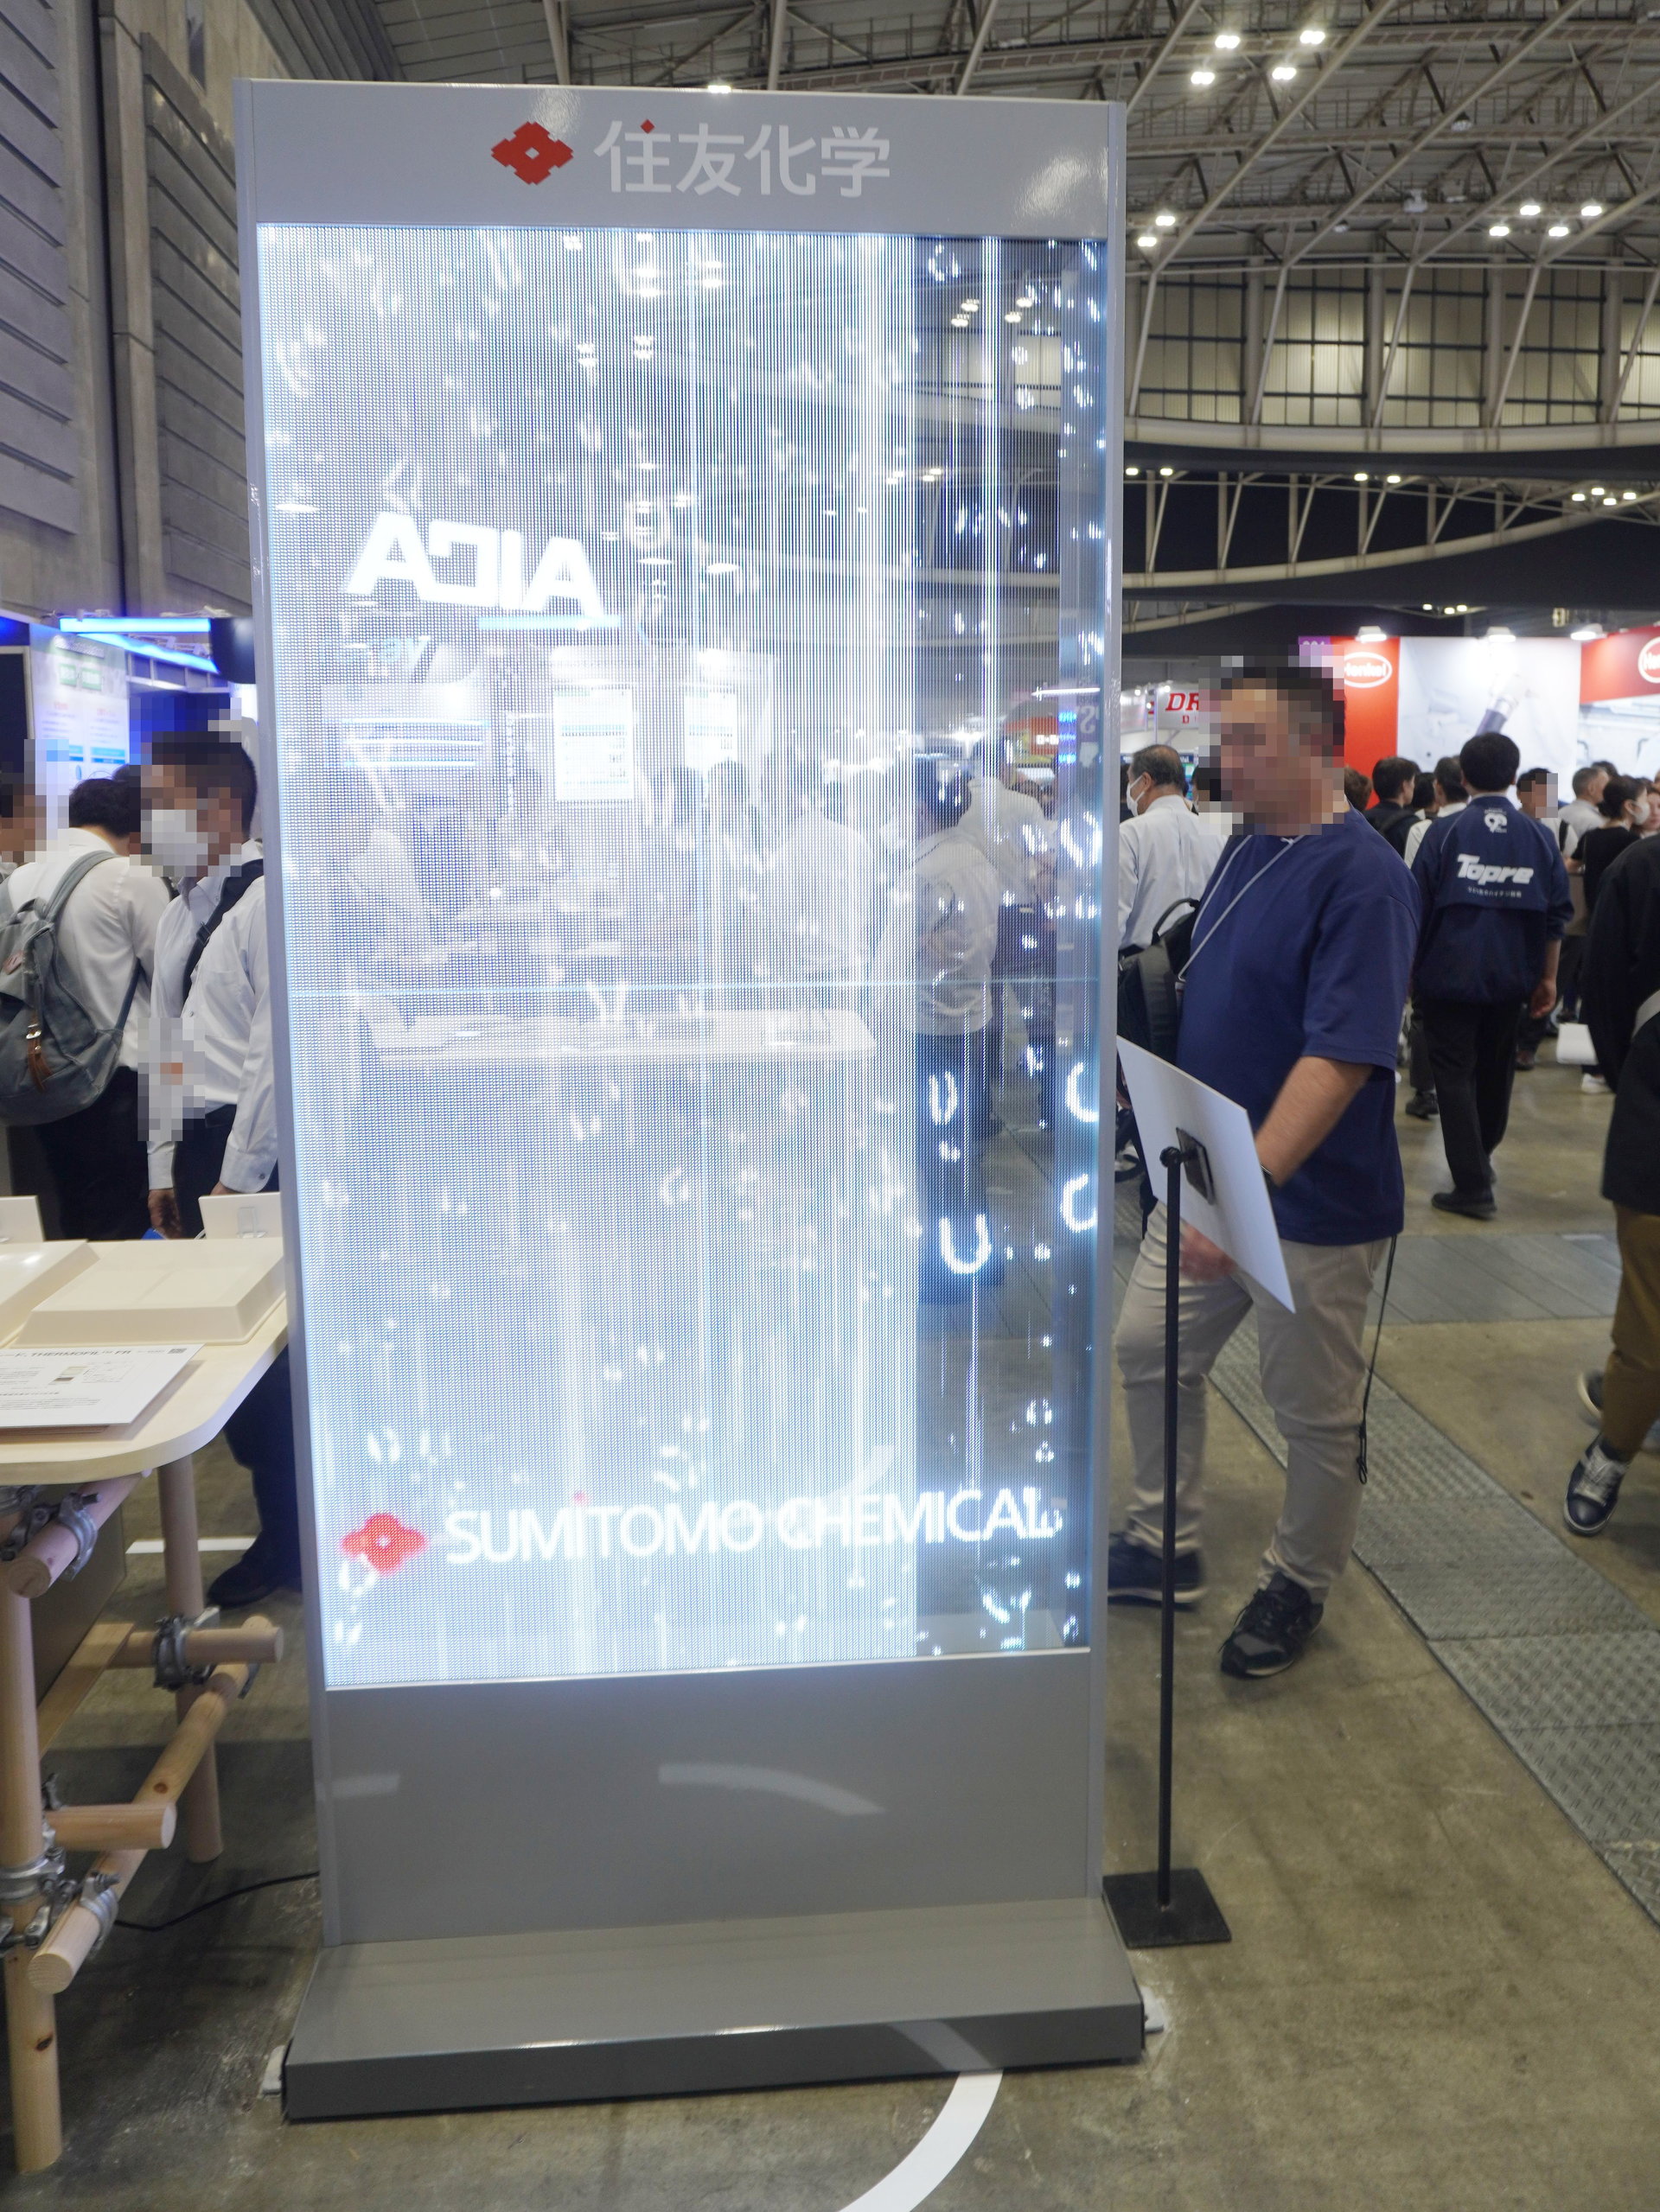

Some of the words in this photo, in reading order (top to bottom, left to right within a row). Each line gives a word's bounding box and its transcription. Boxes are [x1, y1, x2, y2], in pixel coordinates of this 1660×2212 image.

[594, 118, 891, 198] 住友化学
[1457, 853, 1534, 885] Topre
[444, 1493, 763, 1565] SUMITOMO
[777, 1487, 1057, 1549] CHEMICAL
